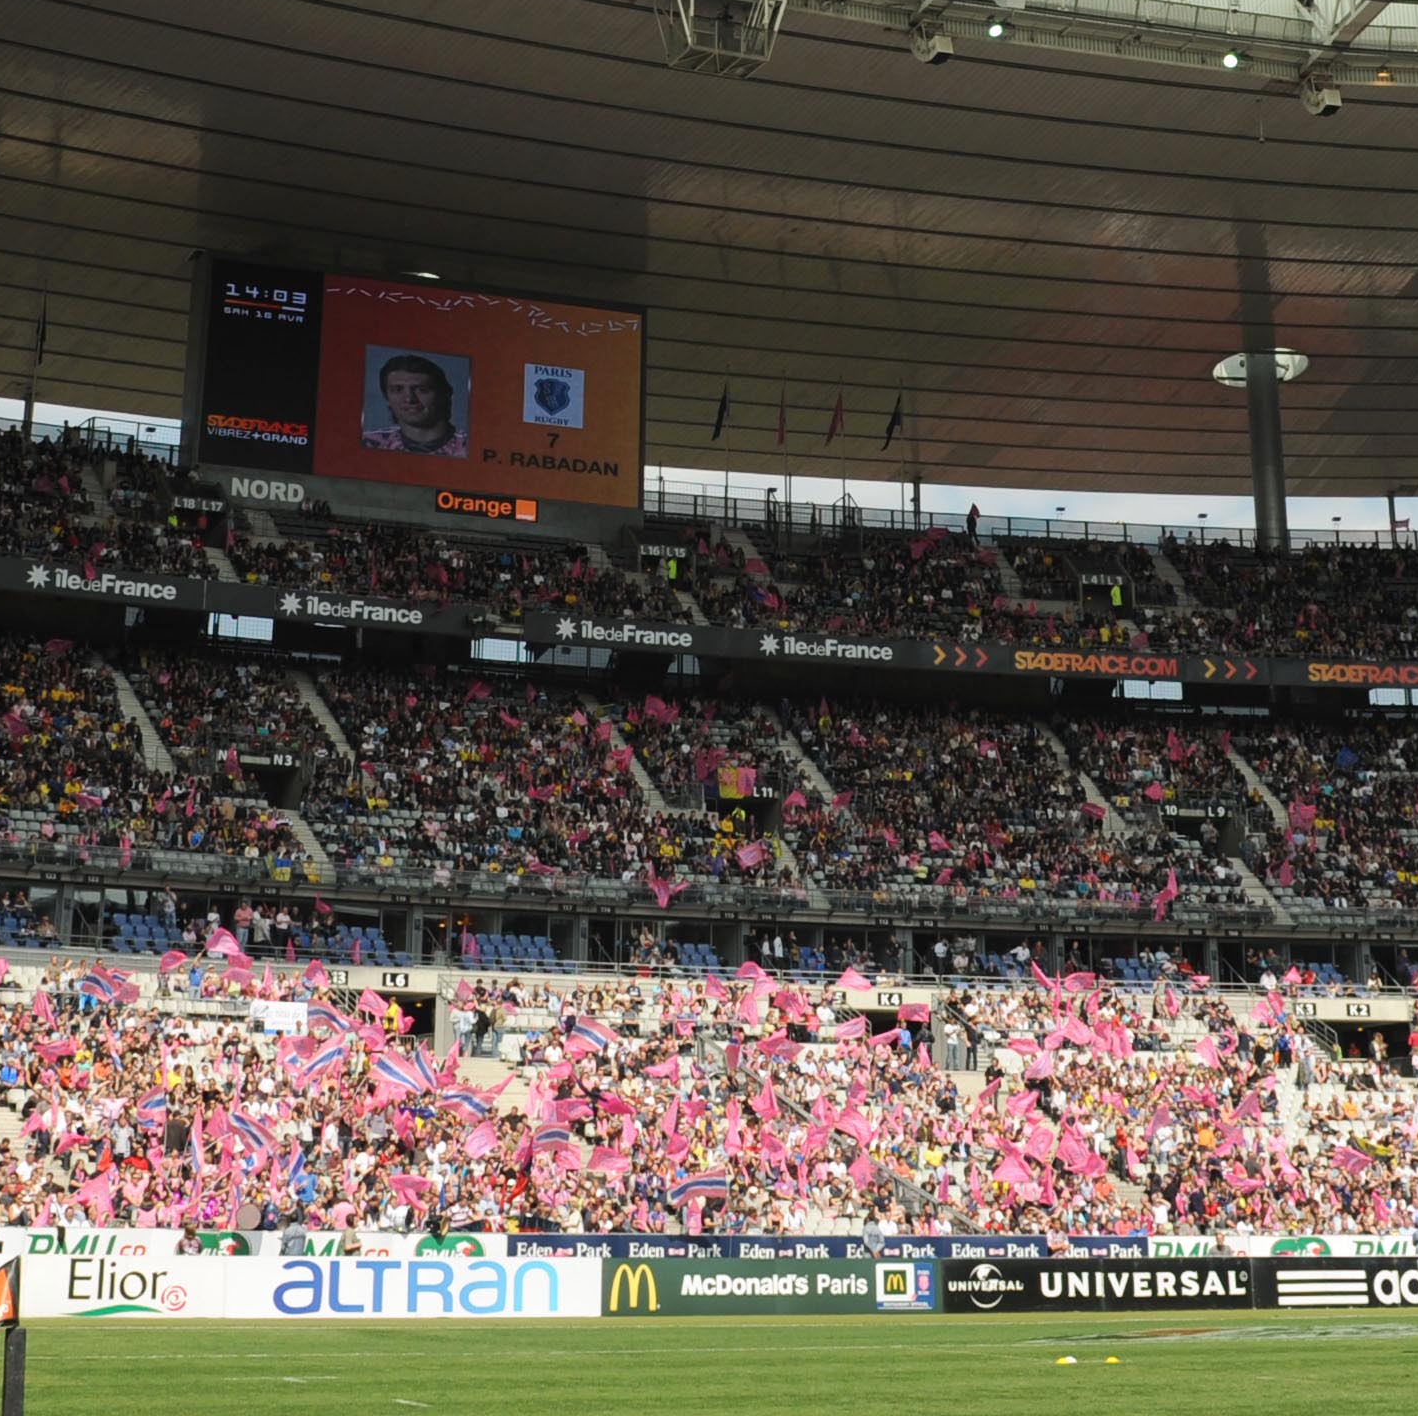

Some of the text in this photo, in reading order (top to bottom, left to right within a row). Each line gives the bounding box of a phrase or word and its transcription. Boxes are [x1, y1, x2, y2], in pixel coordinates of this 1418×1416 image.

[225, 283, 307, 305] 14:03
[534, 365, 574, 379] PARIS
[534, 415, 570, 427] RUGBY
[547, 433, 560, 449] 7
[483, 448, 619, 477] P. RABADAN
[231, 477, 305, 503] NORD
[174, 496, 224, 513] L18 L17
[437, 491, 513, 518] Orange
[641, 544, 686, 559] L16 L15
[1014, 651, 1178, 677] STADEFRANCE.COM
[271, 753, 294, 768] N3
[753, 785, 774, 799] L11
[385, 973, 407, 987] L6
[881, 992, 903, 1006] K4
[1294, 1002, 1314, 1016] K3
[1348, 1002, 1368, 1016] K2
[517, 1242, 612, 1258] Eden Park
[629, 1242, 722, 1258] Eden Park
[739, 1244, 830, 1259] Eden Park
[902, 1244, 935, 1259] Park
[951, 1244, 1040, 1258] Eden Park
[1109, 1244, 1143, 1259] Park
[68, 1258, 168, 1301] Elior
[680, 1273, 868, 1297] McDonald's Paris
[948, 1278, 1024, 1292] UNIVERSAL
[1040, 1271, 1247, 1298] UNIVERSAL
